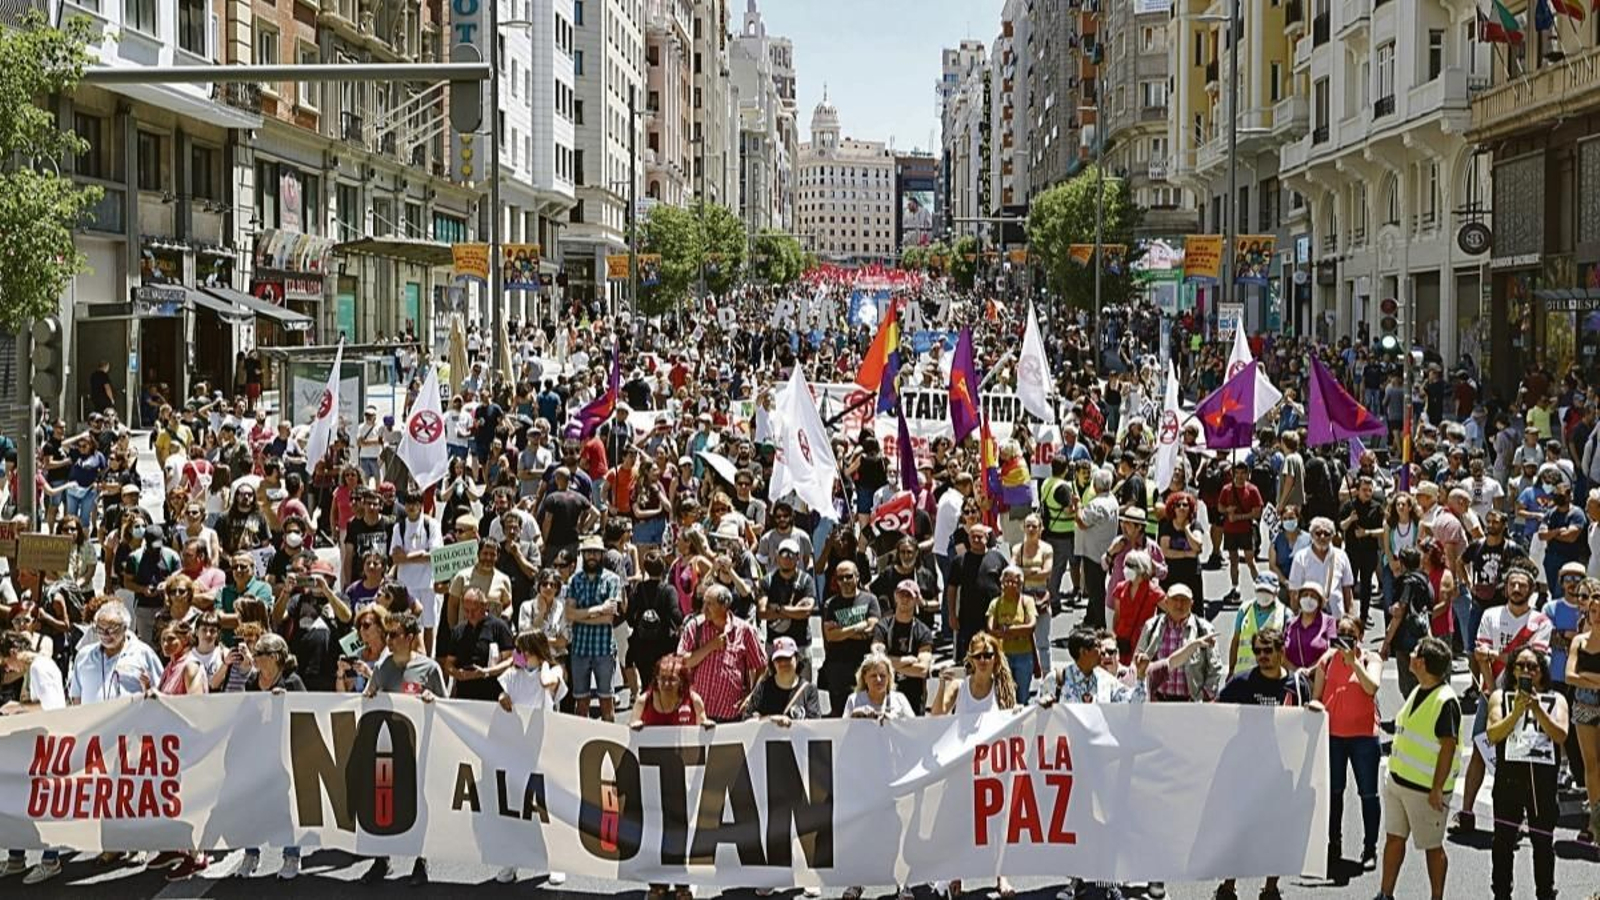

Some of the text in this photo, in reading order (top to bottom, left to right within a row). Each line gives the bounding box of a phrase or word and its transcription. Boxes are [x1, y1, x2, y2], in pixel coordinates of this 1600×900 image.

[28, 735, 180, 777] NO A LAS
[290, 709, 417, 836] NO
[974, 735, 1073, 775] POR LA
[27, 777, 182, 819] GUERRAS
[452, 763, 550, 823] A LA
[578, 739, 834, 868] OTAN
[974, 774, 1076, 845] PAZ
